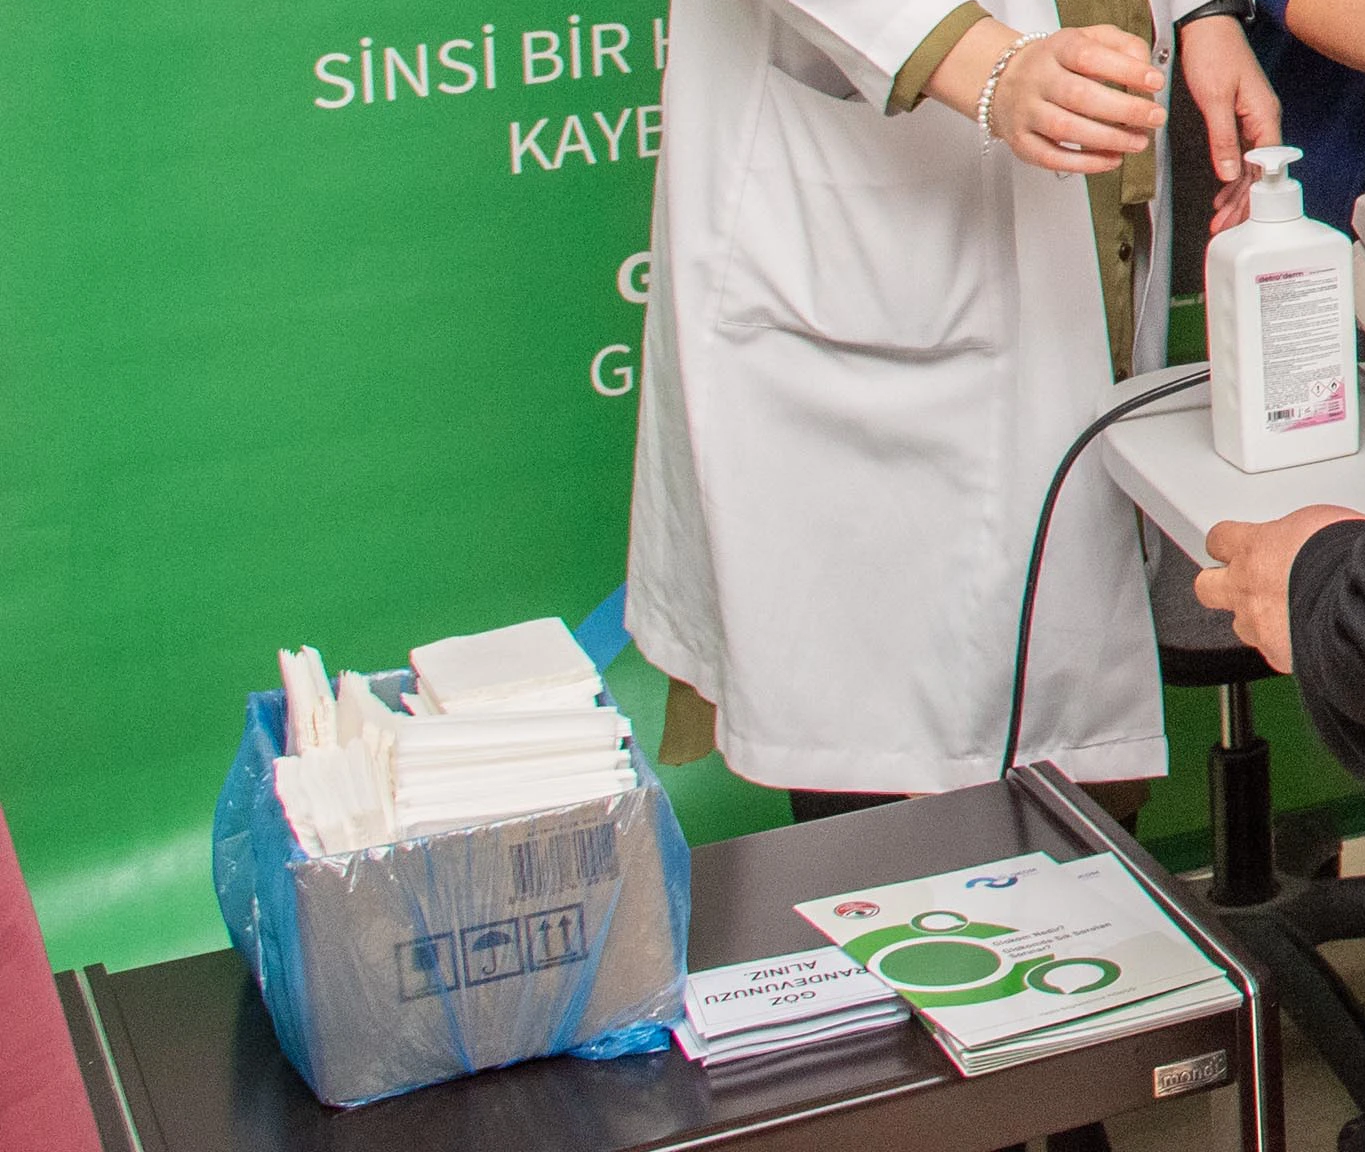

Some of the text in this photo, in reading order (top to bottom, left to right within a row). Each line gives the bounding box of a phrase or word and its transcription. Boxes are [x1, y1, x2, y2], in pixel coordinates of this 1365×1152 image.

[314, 24, 496, 109] SİNSİ
[522, 14, 632, 85] BİR
[705, 968, 868, 1005] RANDEVUNUZU
[771, 990, 816, 1006] GÖZ
